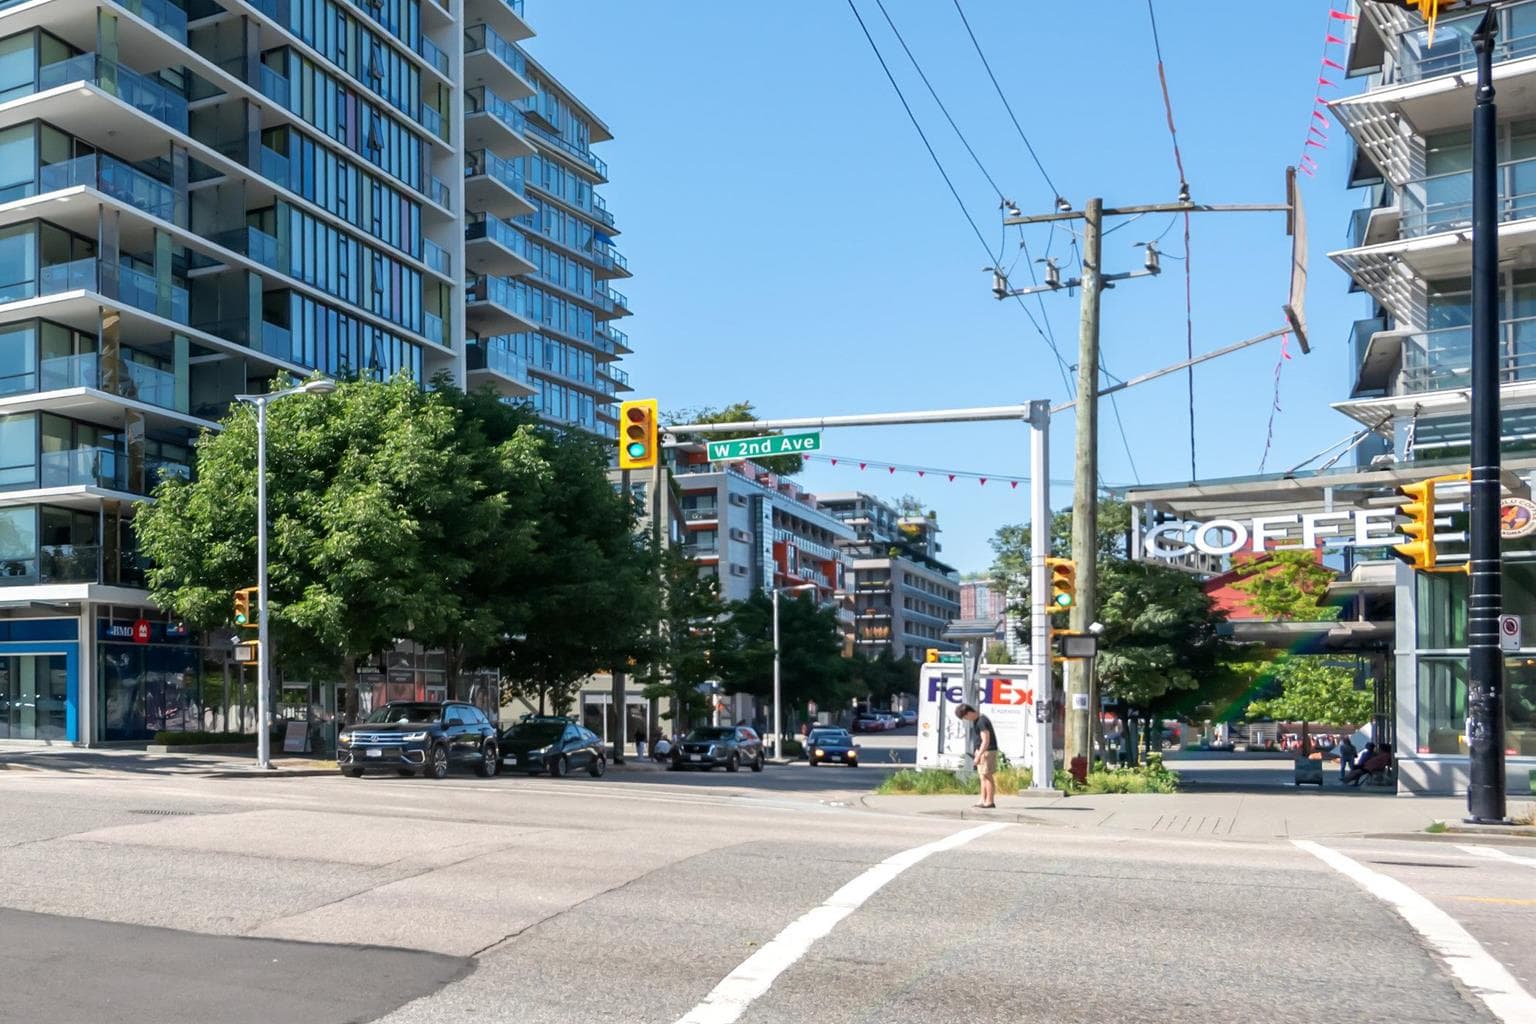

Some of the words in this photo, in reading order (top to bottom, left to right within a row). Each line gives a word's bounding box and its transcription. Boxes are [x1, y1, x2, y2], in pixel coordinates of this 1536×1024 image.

[714, 445, 730, 457] W
[739, 440, 771, 455] 2nd
[780, 437, 814, 451] Ave
[112, 626, 134, 637] BMO
